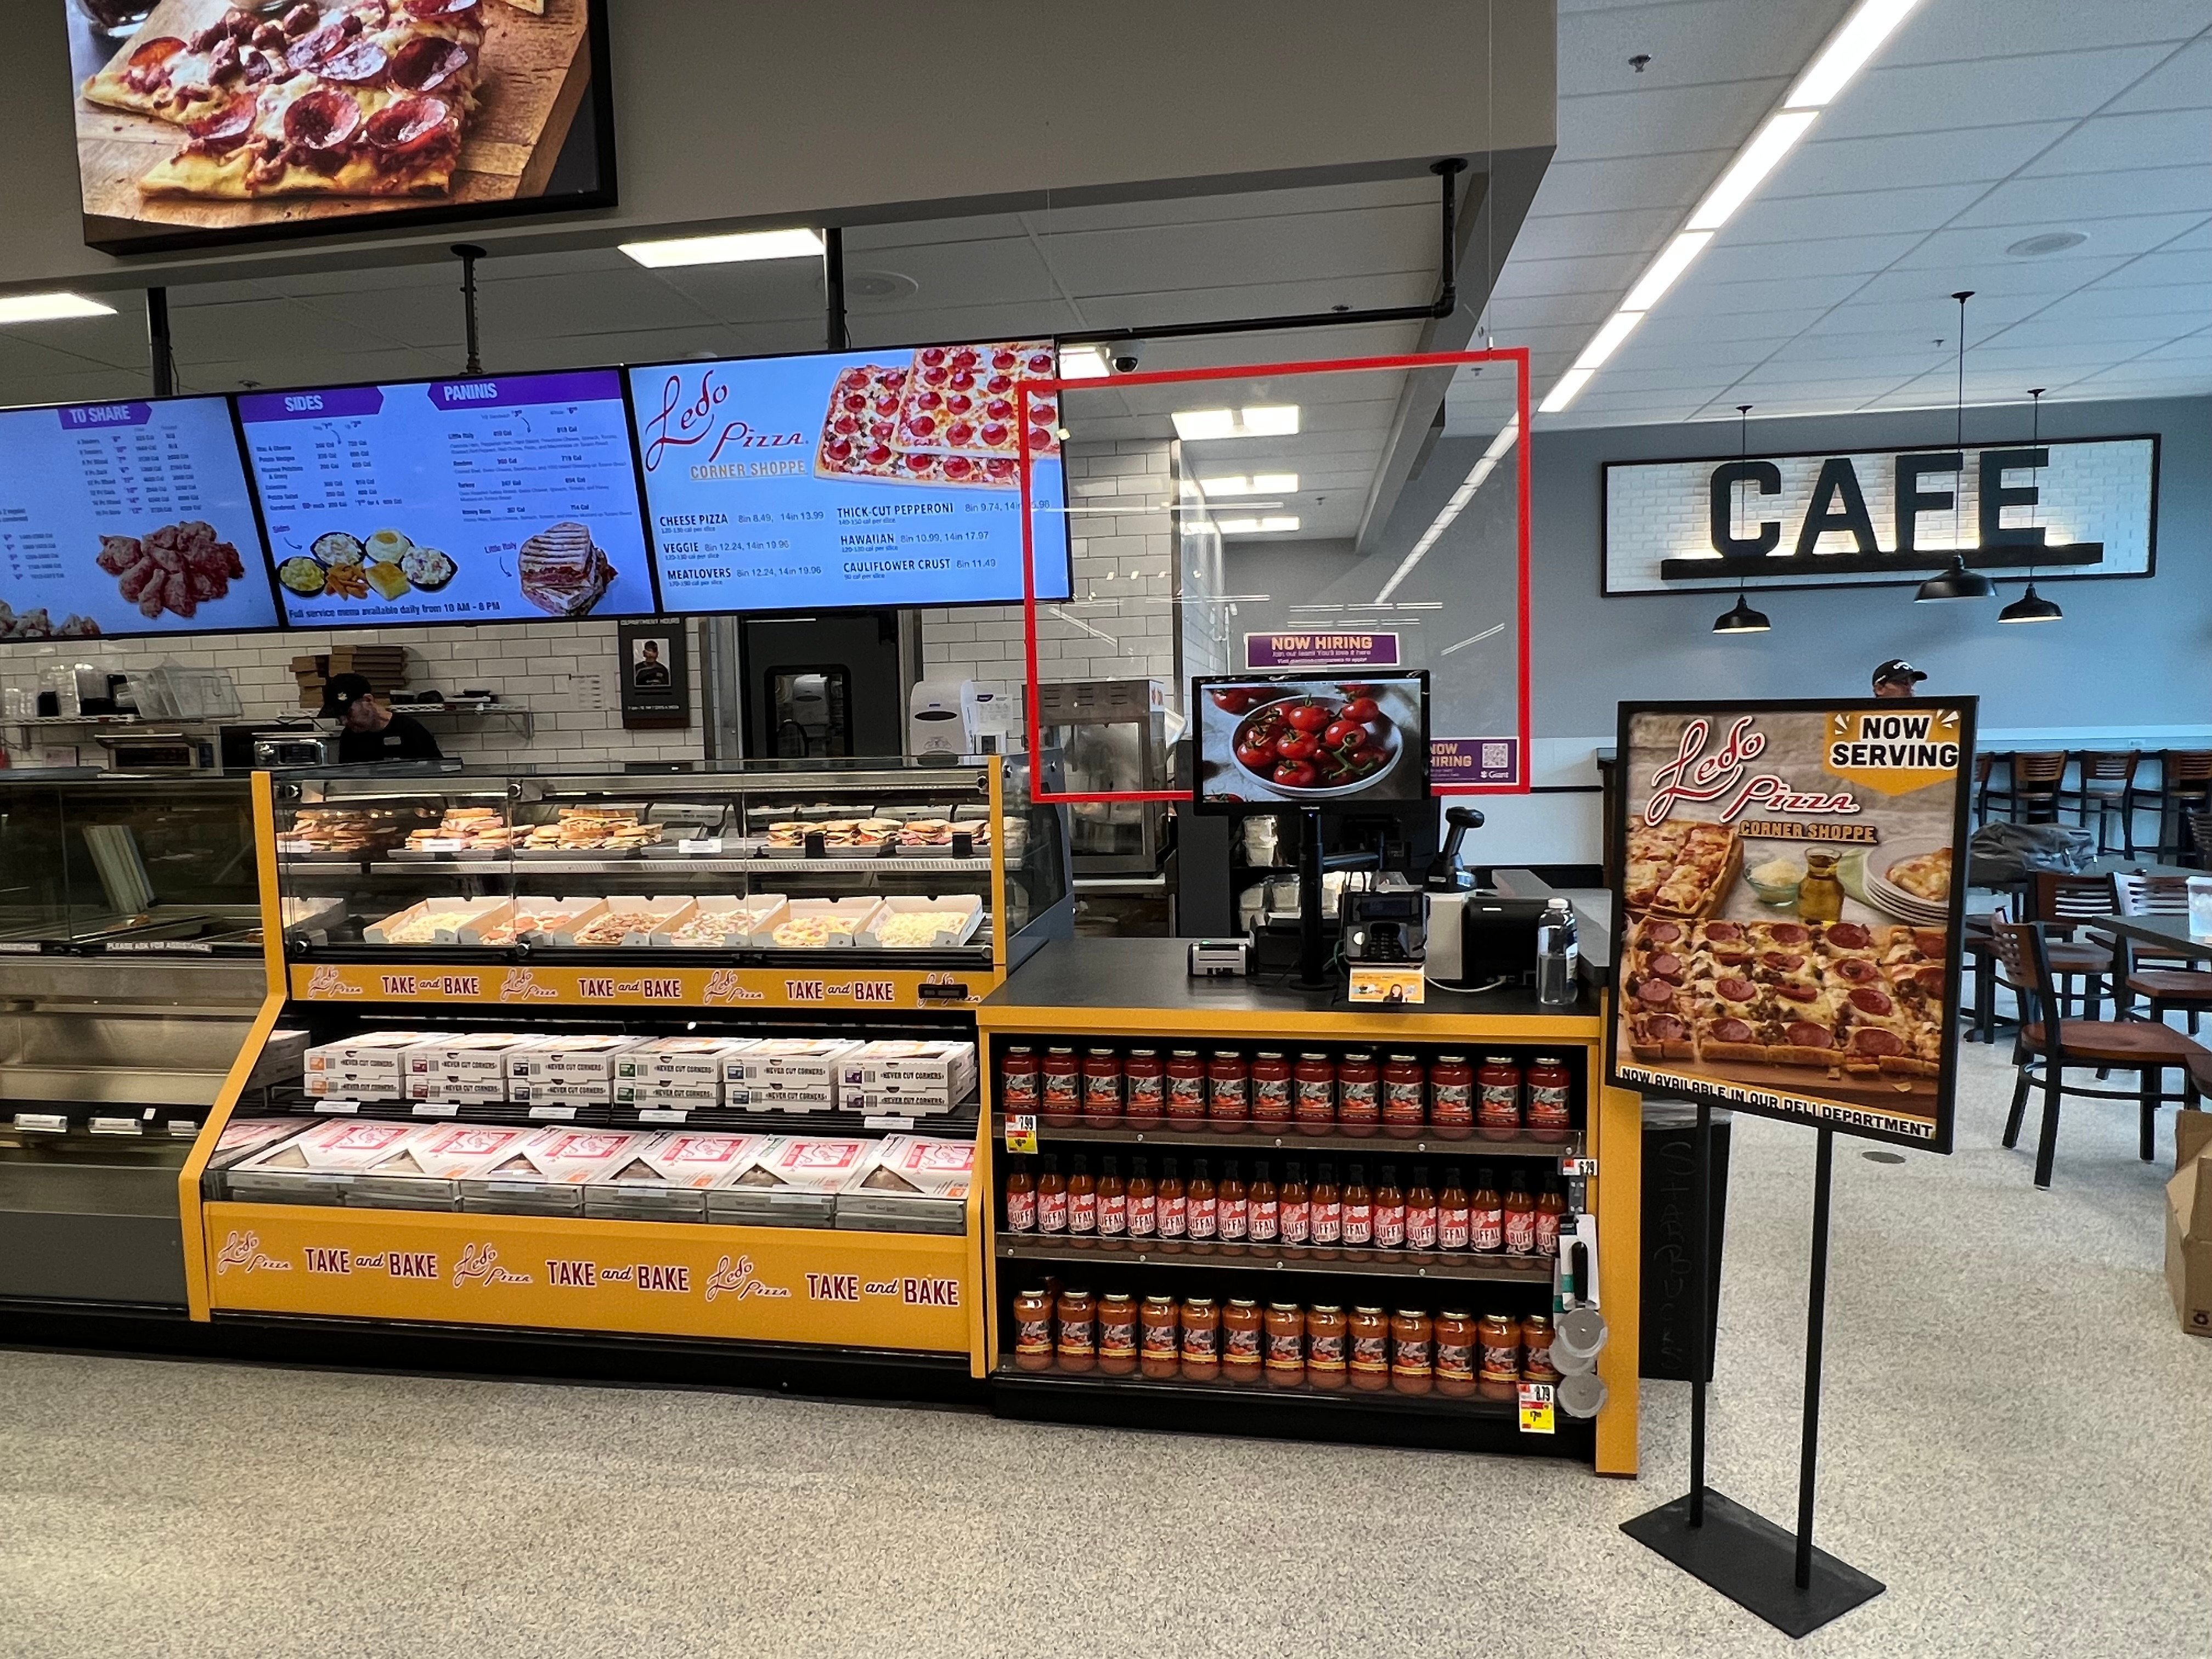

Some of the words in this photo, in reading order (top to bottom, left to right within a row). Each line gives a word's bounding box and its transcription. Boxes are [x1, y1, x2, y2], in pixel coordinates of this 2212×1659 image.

[285, 395, 324, 411] SIDES
[444, 383, 498, 402] PANINIS
[69, 409, 87, 424] TO
[89, 405, 131, 422] SHARE
[645, 369, 728, 472] Ledo
[708, 422, 805, 462] Pizza
[690, 462, 747, 481] CORNER
[749, 459, 806, 477] SHOPPE
[837, 506, 891, 518] THICK-CUT
[895, 503, 953, 515] PEPPERONI
[1710, 448, 2050, 557] CAFE
[660, 515, 697, 527] CHEESE
[699, 514, 729, 525] PIZZA
[781, 512, 799, 521] 14in
[663, 542, 699, 554] VEGGIE
[841, 533, 894, 546] HAWAIIAN
[945, 532, 963, 541] 14in
[667, 568, 731, 580] MEATLOVERS
[844, 560, 915, 573] CAULIFLOWER
[918, 558, 951, 570] CRUST
[289, 608, 304, 619] Full
[306, 607, 335, 618] service
[337, 608, 359, 617] menu
[362, 606, 398, 616] available
[400, 604, 420, 616] daily
[422, 604, 441, 614] from
[443, 603, 455, 613] 10
[456, 602, 470, 612] AM
[486, 601, 500, 611] PM
[1271, 636, 1311, 650] NOW
[1314, 636, 1373, 650] HIRING
[1862, 716, 1929, 740] NOW
[1832, 743, 1959, 768] SERVING
[1646, 716, 1765, 825] Ledo
[1720, 775, 1859, 822] Pizza
[1739, 820, 1802, 838] CORNER
[1807, 823, 1875, 842] SHOPPE
[382, 976, 416, 994] TAKE
[419, 979, 441, 989] and
[443, 977, 479, 995] BAKE
[578, 978, 614, 997] TAKE
[618, 981, 640, 992] and
[644, 980, 681, 998] BAKE
[786, 981, 823, 1000] TAKE
[827, 985, 851, 995] and
[855, 982, 895, 1002] BAKE
[1621, 1068, 1651, 1084] NOW
[1730, 1088, 1746, 1102] IN
[1750, 1092, 1781, 1109] OUR
[1784, 1098, 1818, 1117] DELI
[1822, 1105, 1933, 1138] DEPARTMENT
[218, 1231, 259, 1274] Ledo
[305, 1248, 351, 1272] TAKE
[356, 1255, 384, 1267] and
[389, 1253, 438, 1278] BAKE
[454, 1243, 496, 1287] Ledo
[546, 1261, 596, 1287] TAKE
[601, 1266, 631, 1280] and
[637, 1265, 689, 1291] BAKE
[705, 1255, 753, 1301] Ledo
[807, 1273, 859, 1301] TAKE
[865, 1280, 898, 1295] and
[904, 1279, 959, 1306] BAKE
